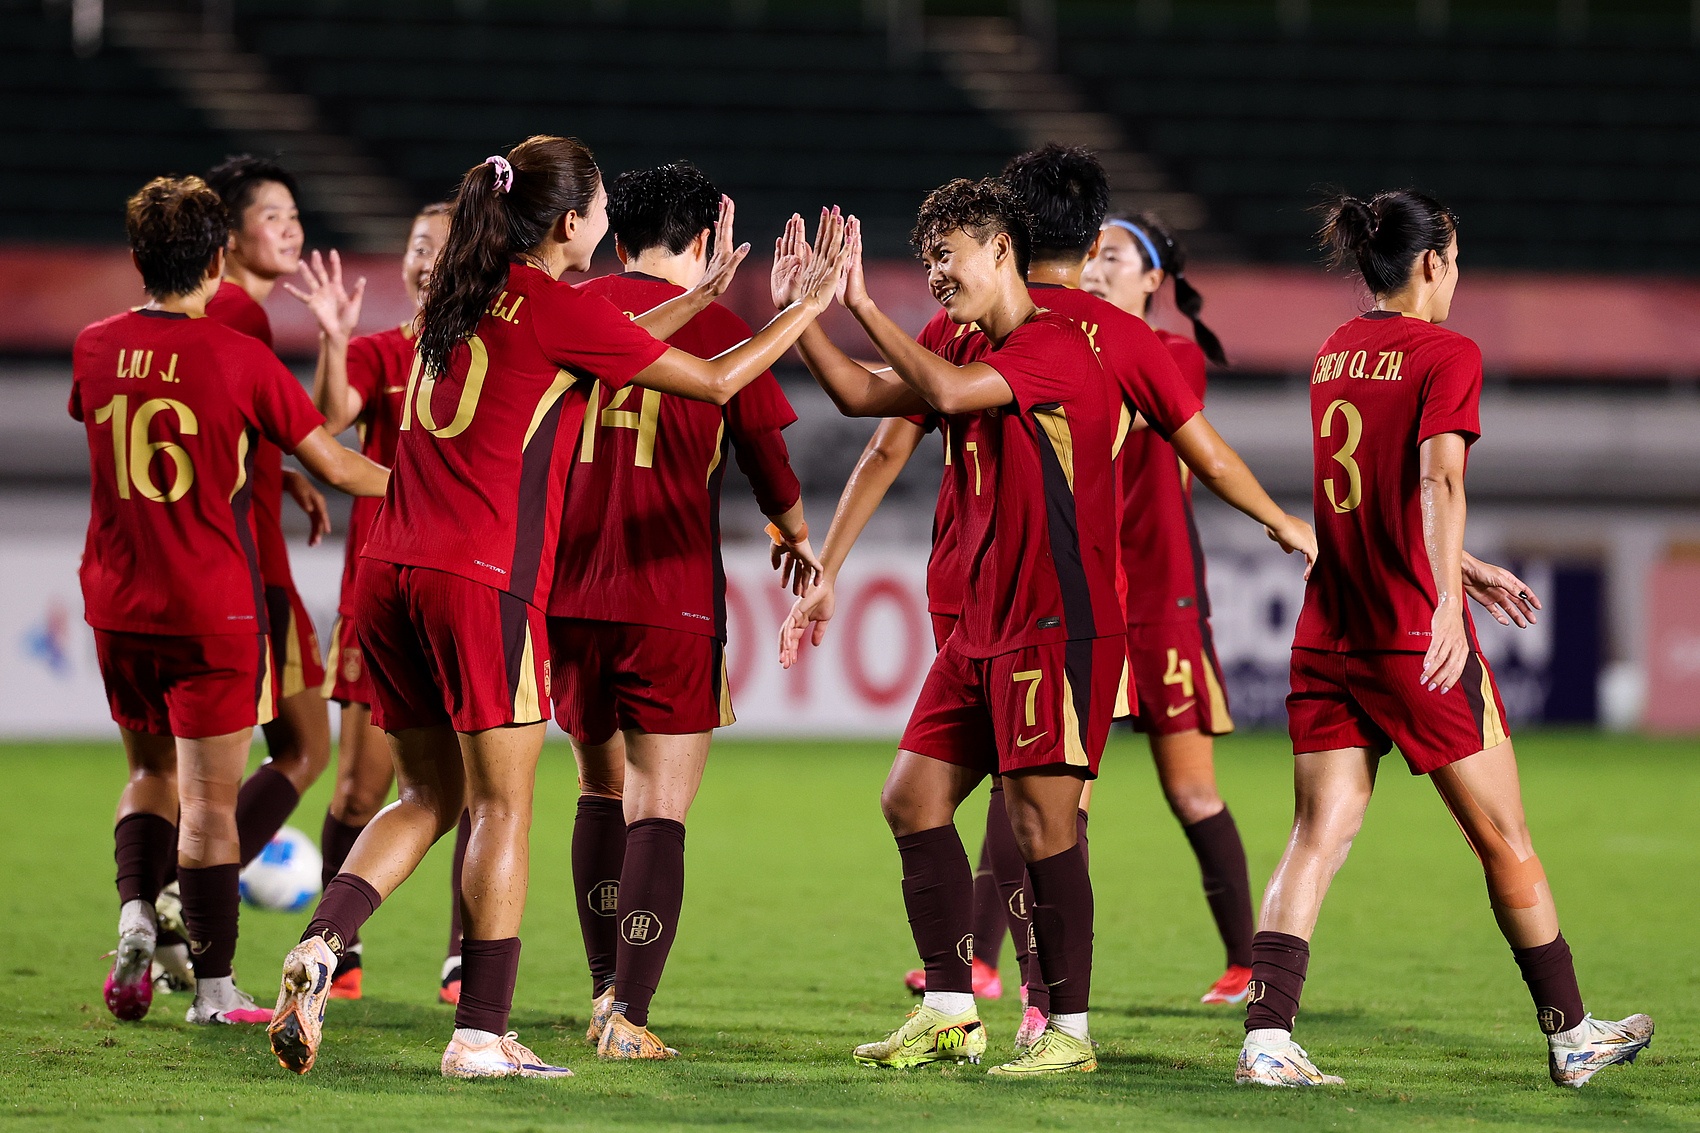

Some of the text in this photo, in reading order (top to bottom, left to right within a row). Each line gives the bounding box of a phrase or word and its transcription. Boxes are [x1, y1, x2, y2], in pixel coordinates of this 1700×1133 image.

[117, 348, 180, 383] LIU J.
[400, 333, 489, 439] 10
[1312, 350, 1404, 385] CHEN Q.ZH.
[95, 394, 199, 503] 16
[580, 378, 662, 469] 14
[1320, 399, 1363, 514] 3
[1012, 669, 1042, 727] 7
[1162, 647, 1194, 698] 4
[630, 915, 651, 941] 中国
